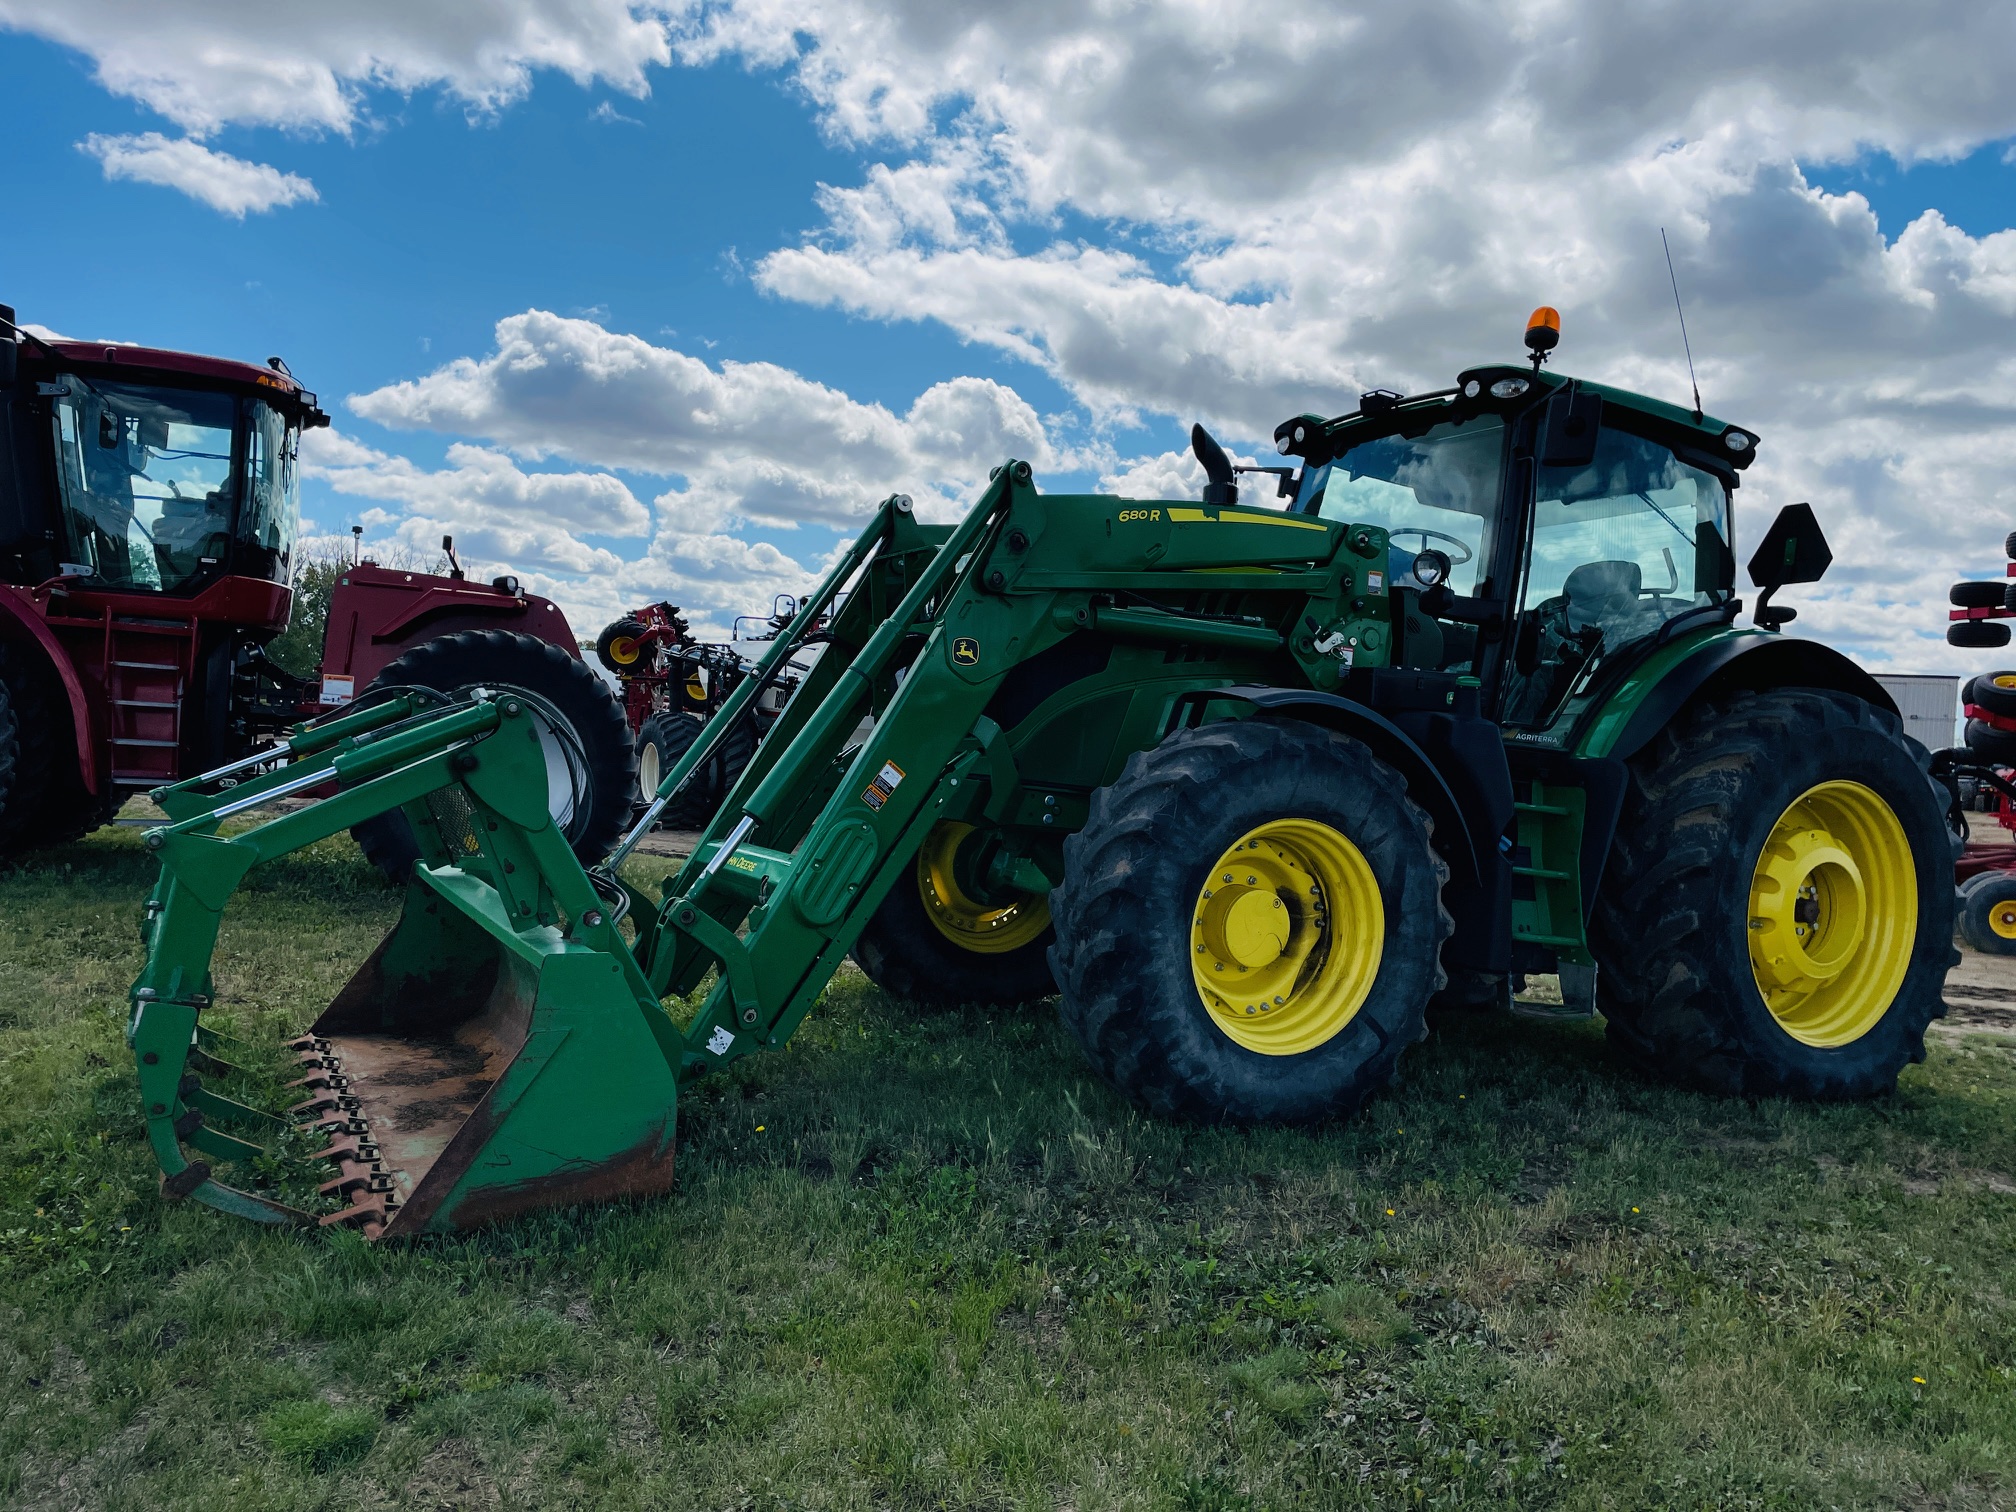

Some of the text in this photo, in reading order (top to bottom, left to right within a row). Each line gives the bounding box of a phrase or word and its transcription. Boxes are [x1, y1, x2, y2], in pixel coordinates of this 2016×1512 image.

[1118, 509, 1161, 522] 680 R
[1515, 733, 1559, 744] AGRITERRA
